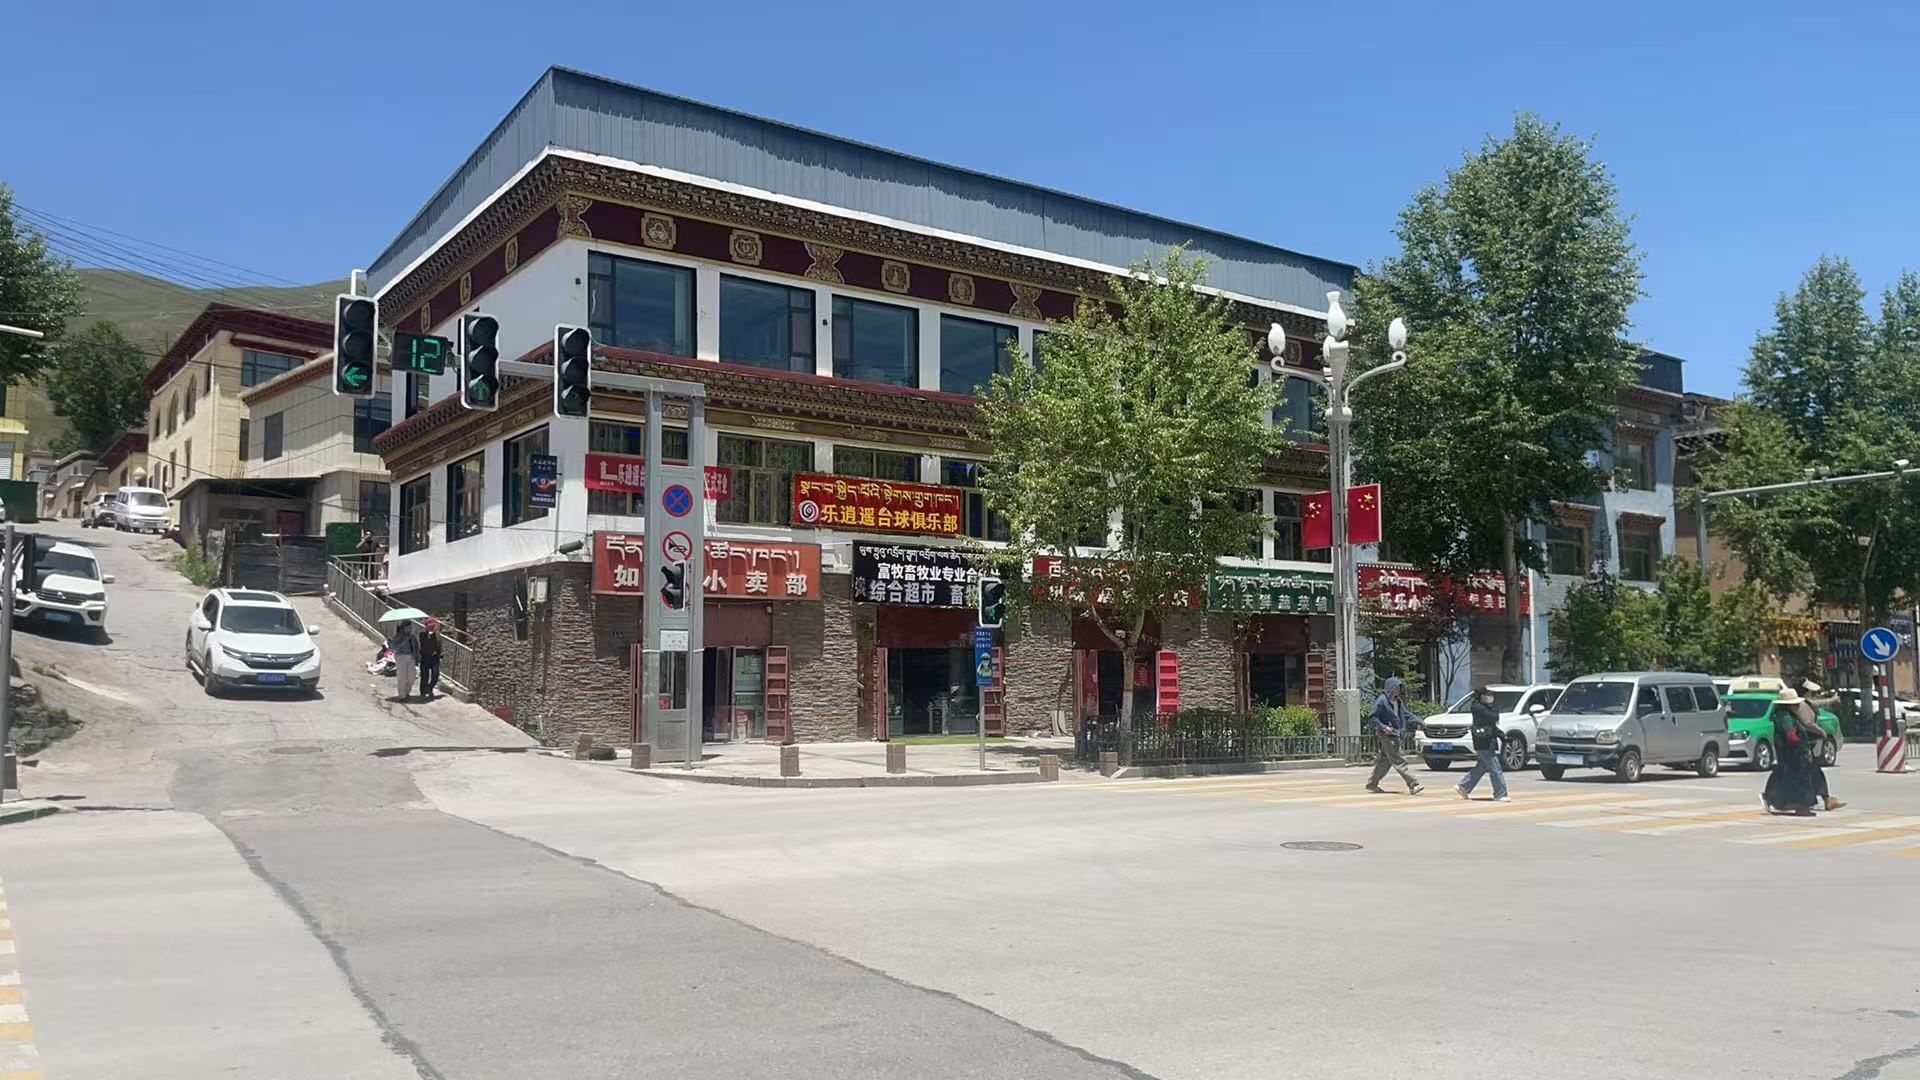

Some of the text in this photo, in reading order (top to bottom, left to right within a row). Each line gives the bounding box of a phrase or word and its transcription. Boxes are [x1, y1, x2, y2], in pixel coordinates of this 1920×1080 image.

[411, 338, 441, 373] 12
[821, 504, 958, 533] 乐逍遥台球俱乐部
[614, 564, 807, 596] 如小卖部
[869, 580, 936, 605] 综合超市
